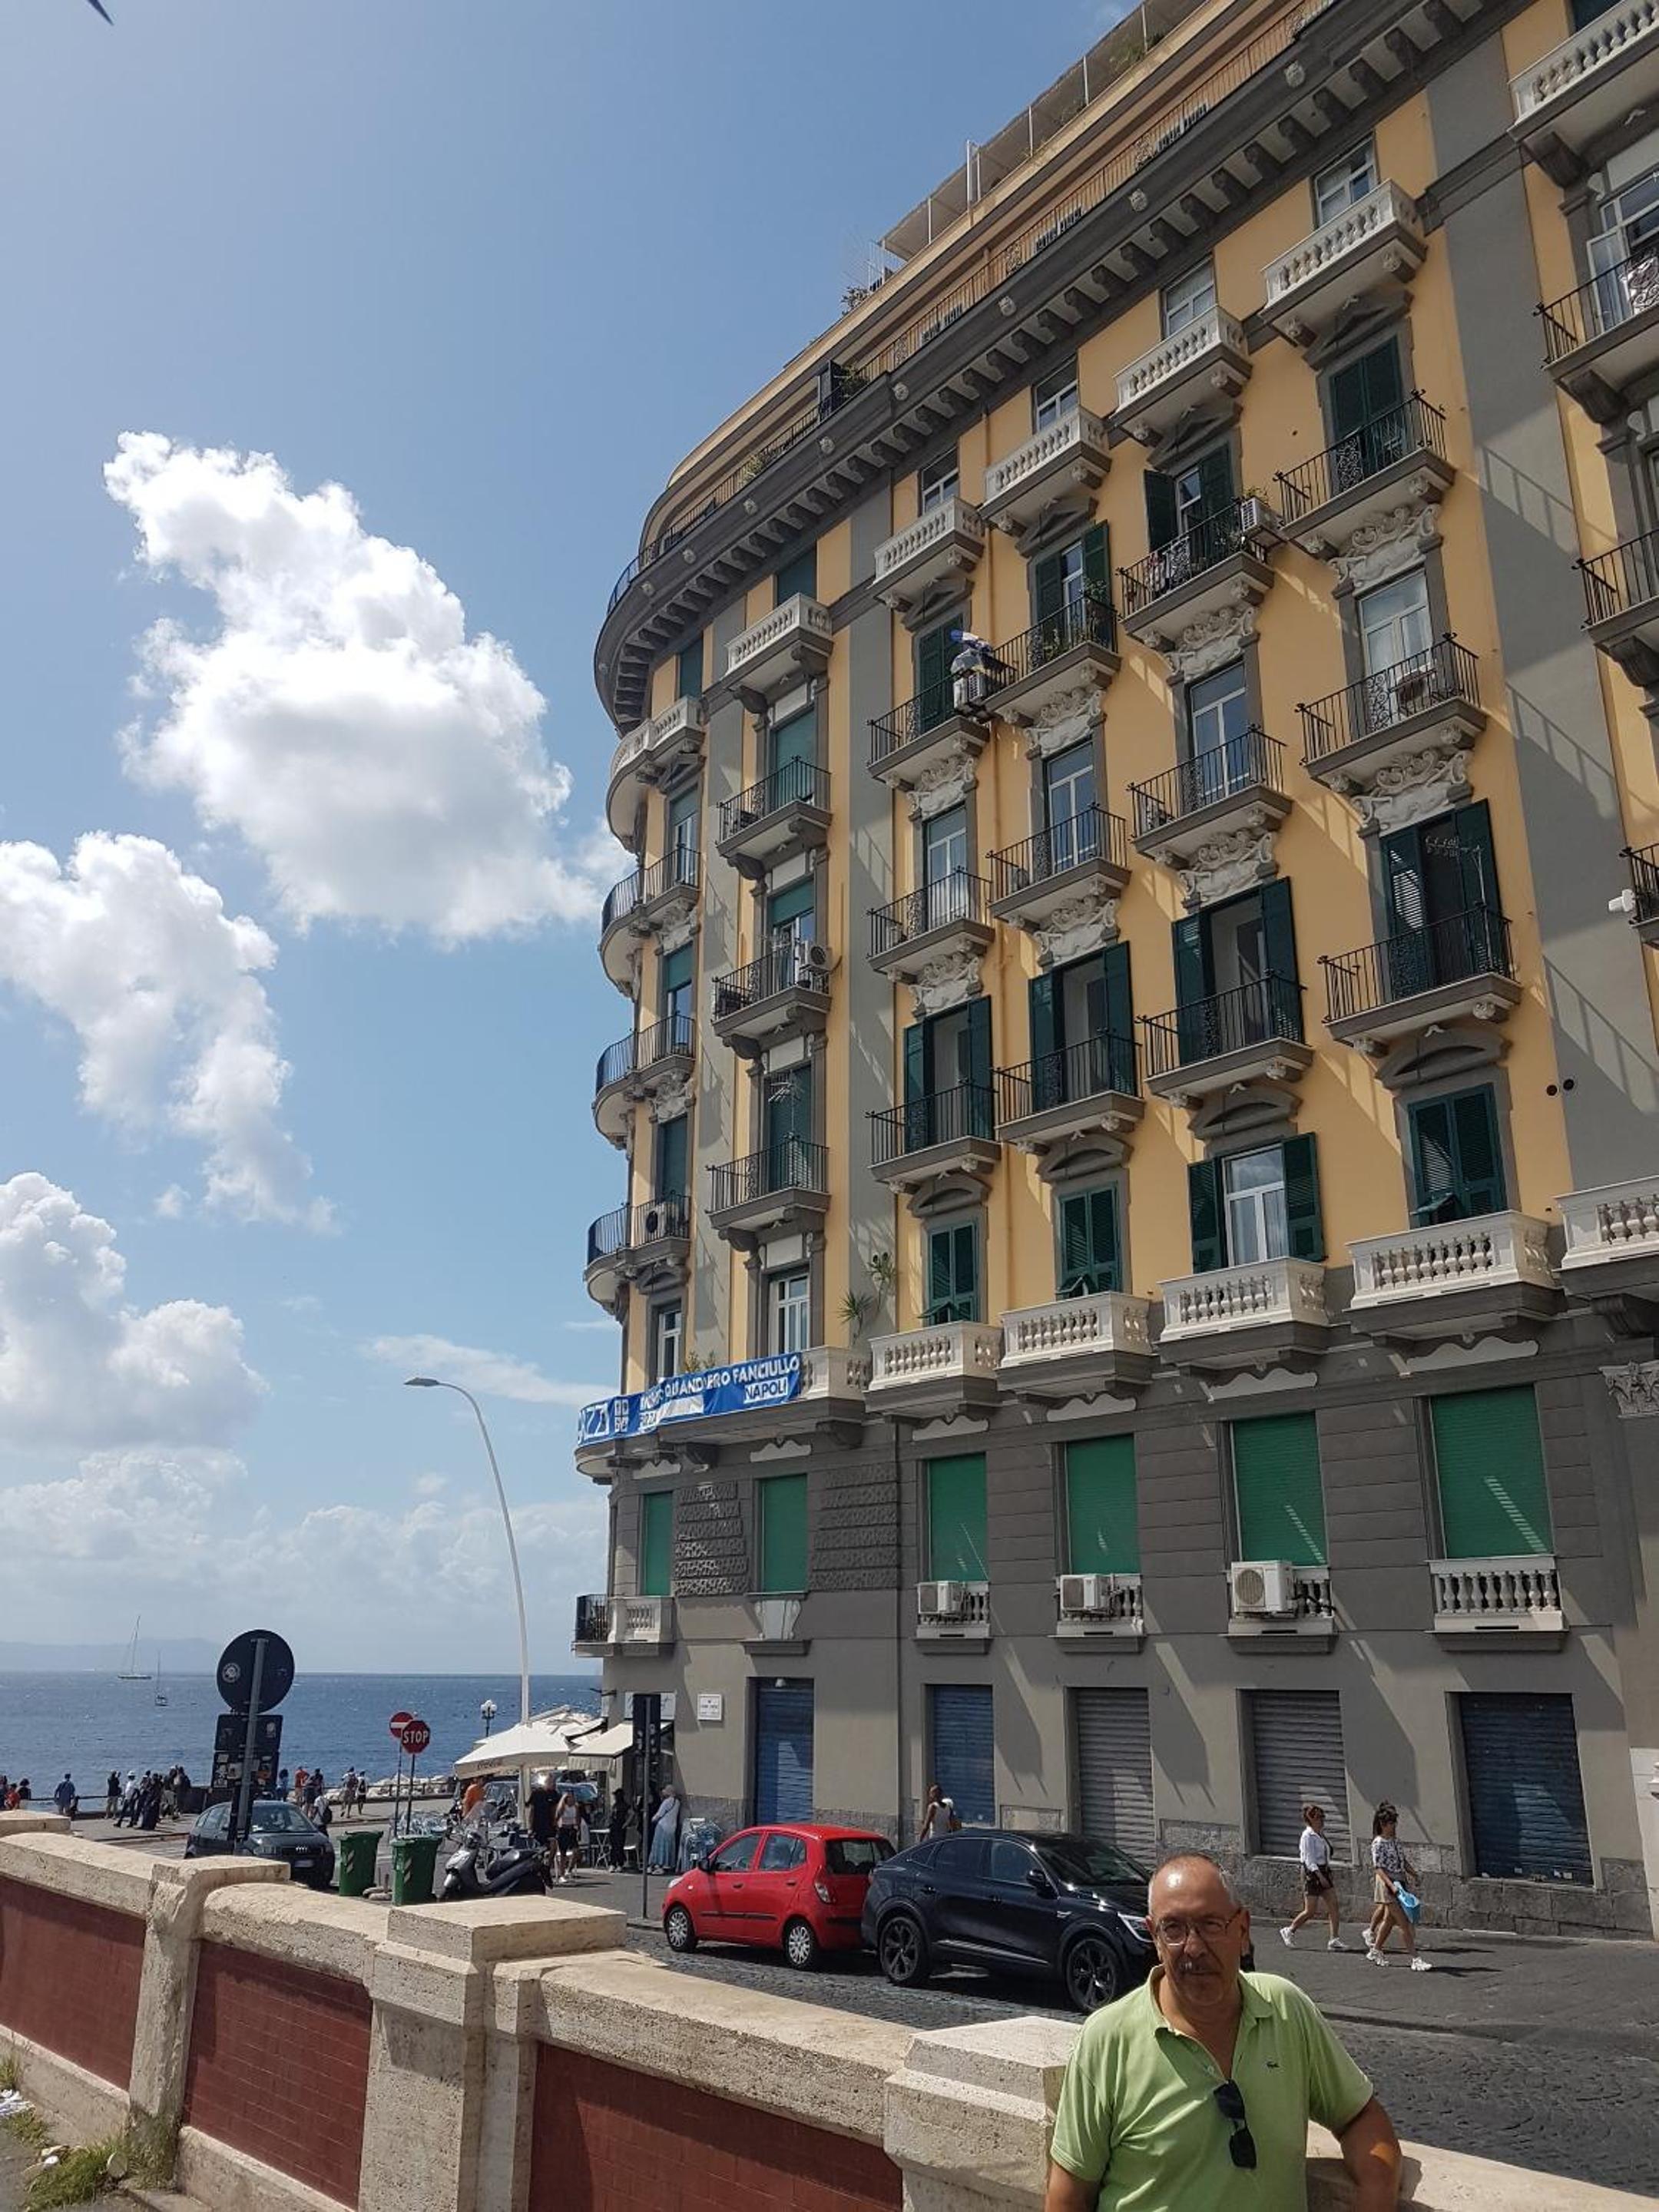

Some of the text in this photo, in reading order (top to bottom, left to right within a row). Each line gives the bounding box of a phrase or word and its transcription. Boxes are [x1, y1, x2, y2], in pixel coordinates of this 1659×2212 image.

[732, 1355, 800, 1384] FANCIULLO
[745, 1378, 786, 1399] NAPOLI
[403, 1730, 429, 1743] STOP
